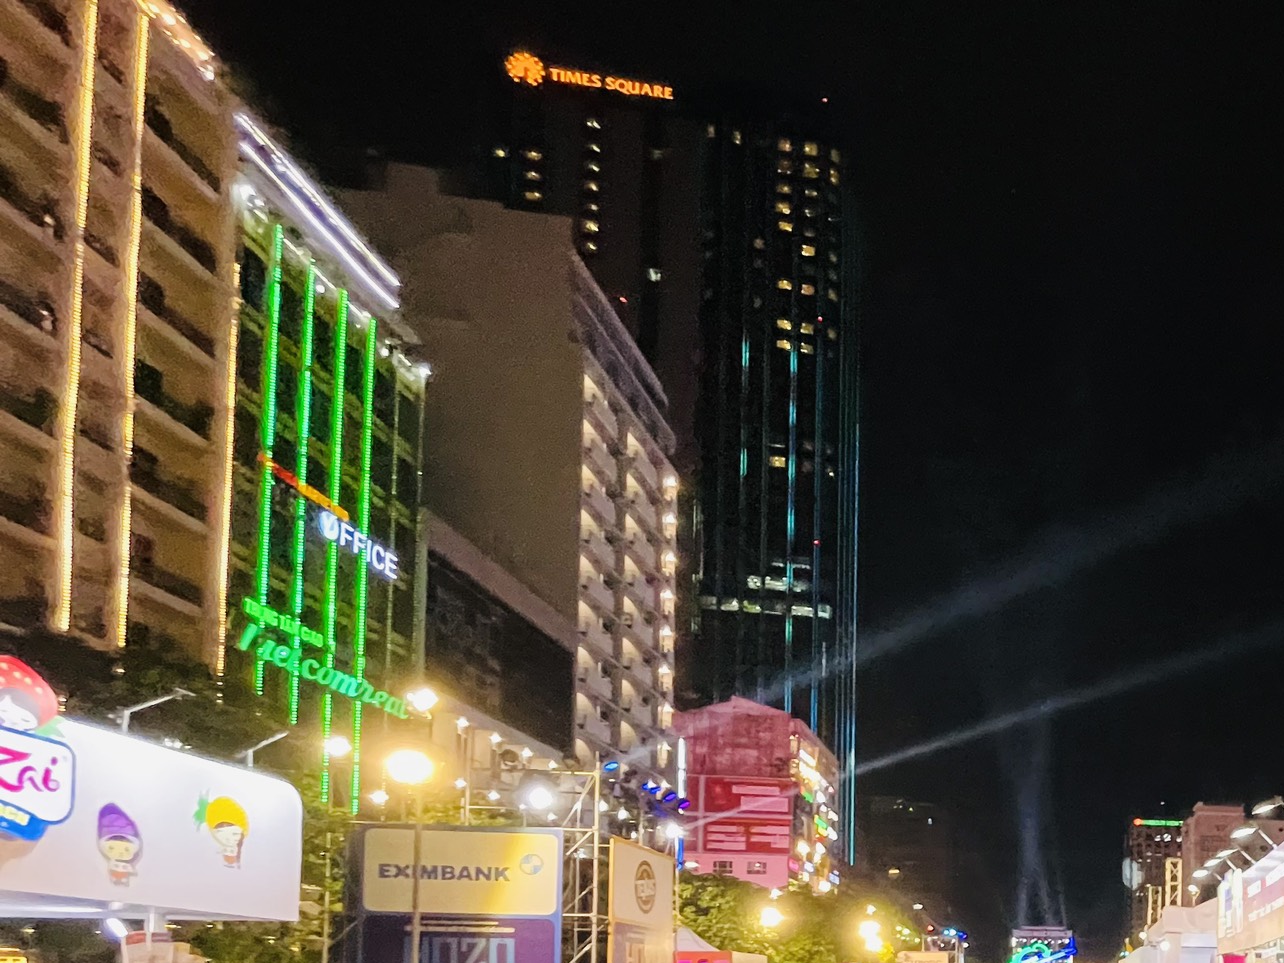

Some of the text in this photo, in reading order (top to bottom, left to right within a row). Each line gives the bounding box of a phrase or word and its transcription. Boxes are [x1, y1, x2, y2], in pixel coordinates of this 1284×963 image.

[549, 67, 674, 100] TIMES SQUARE
[378, 863, 511, 882] EXMBANK
